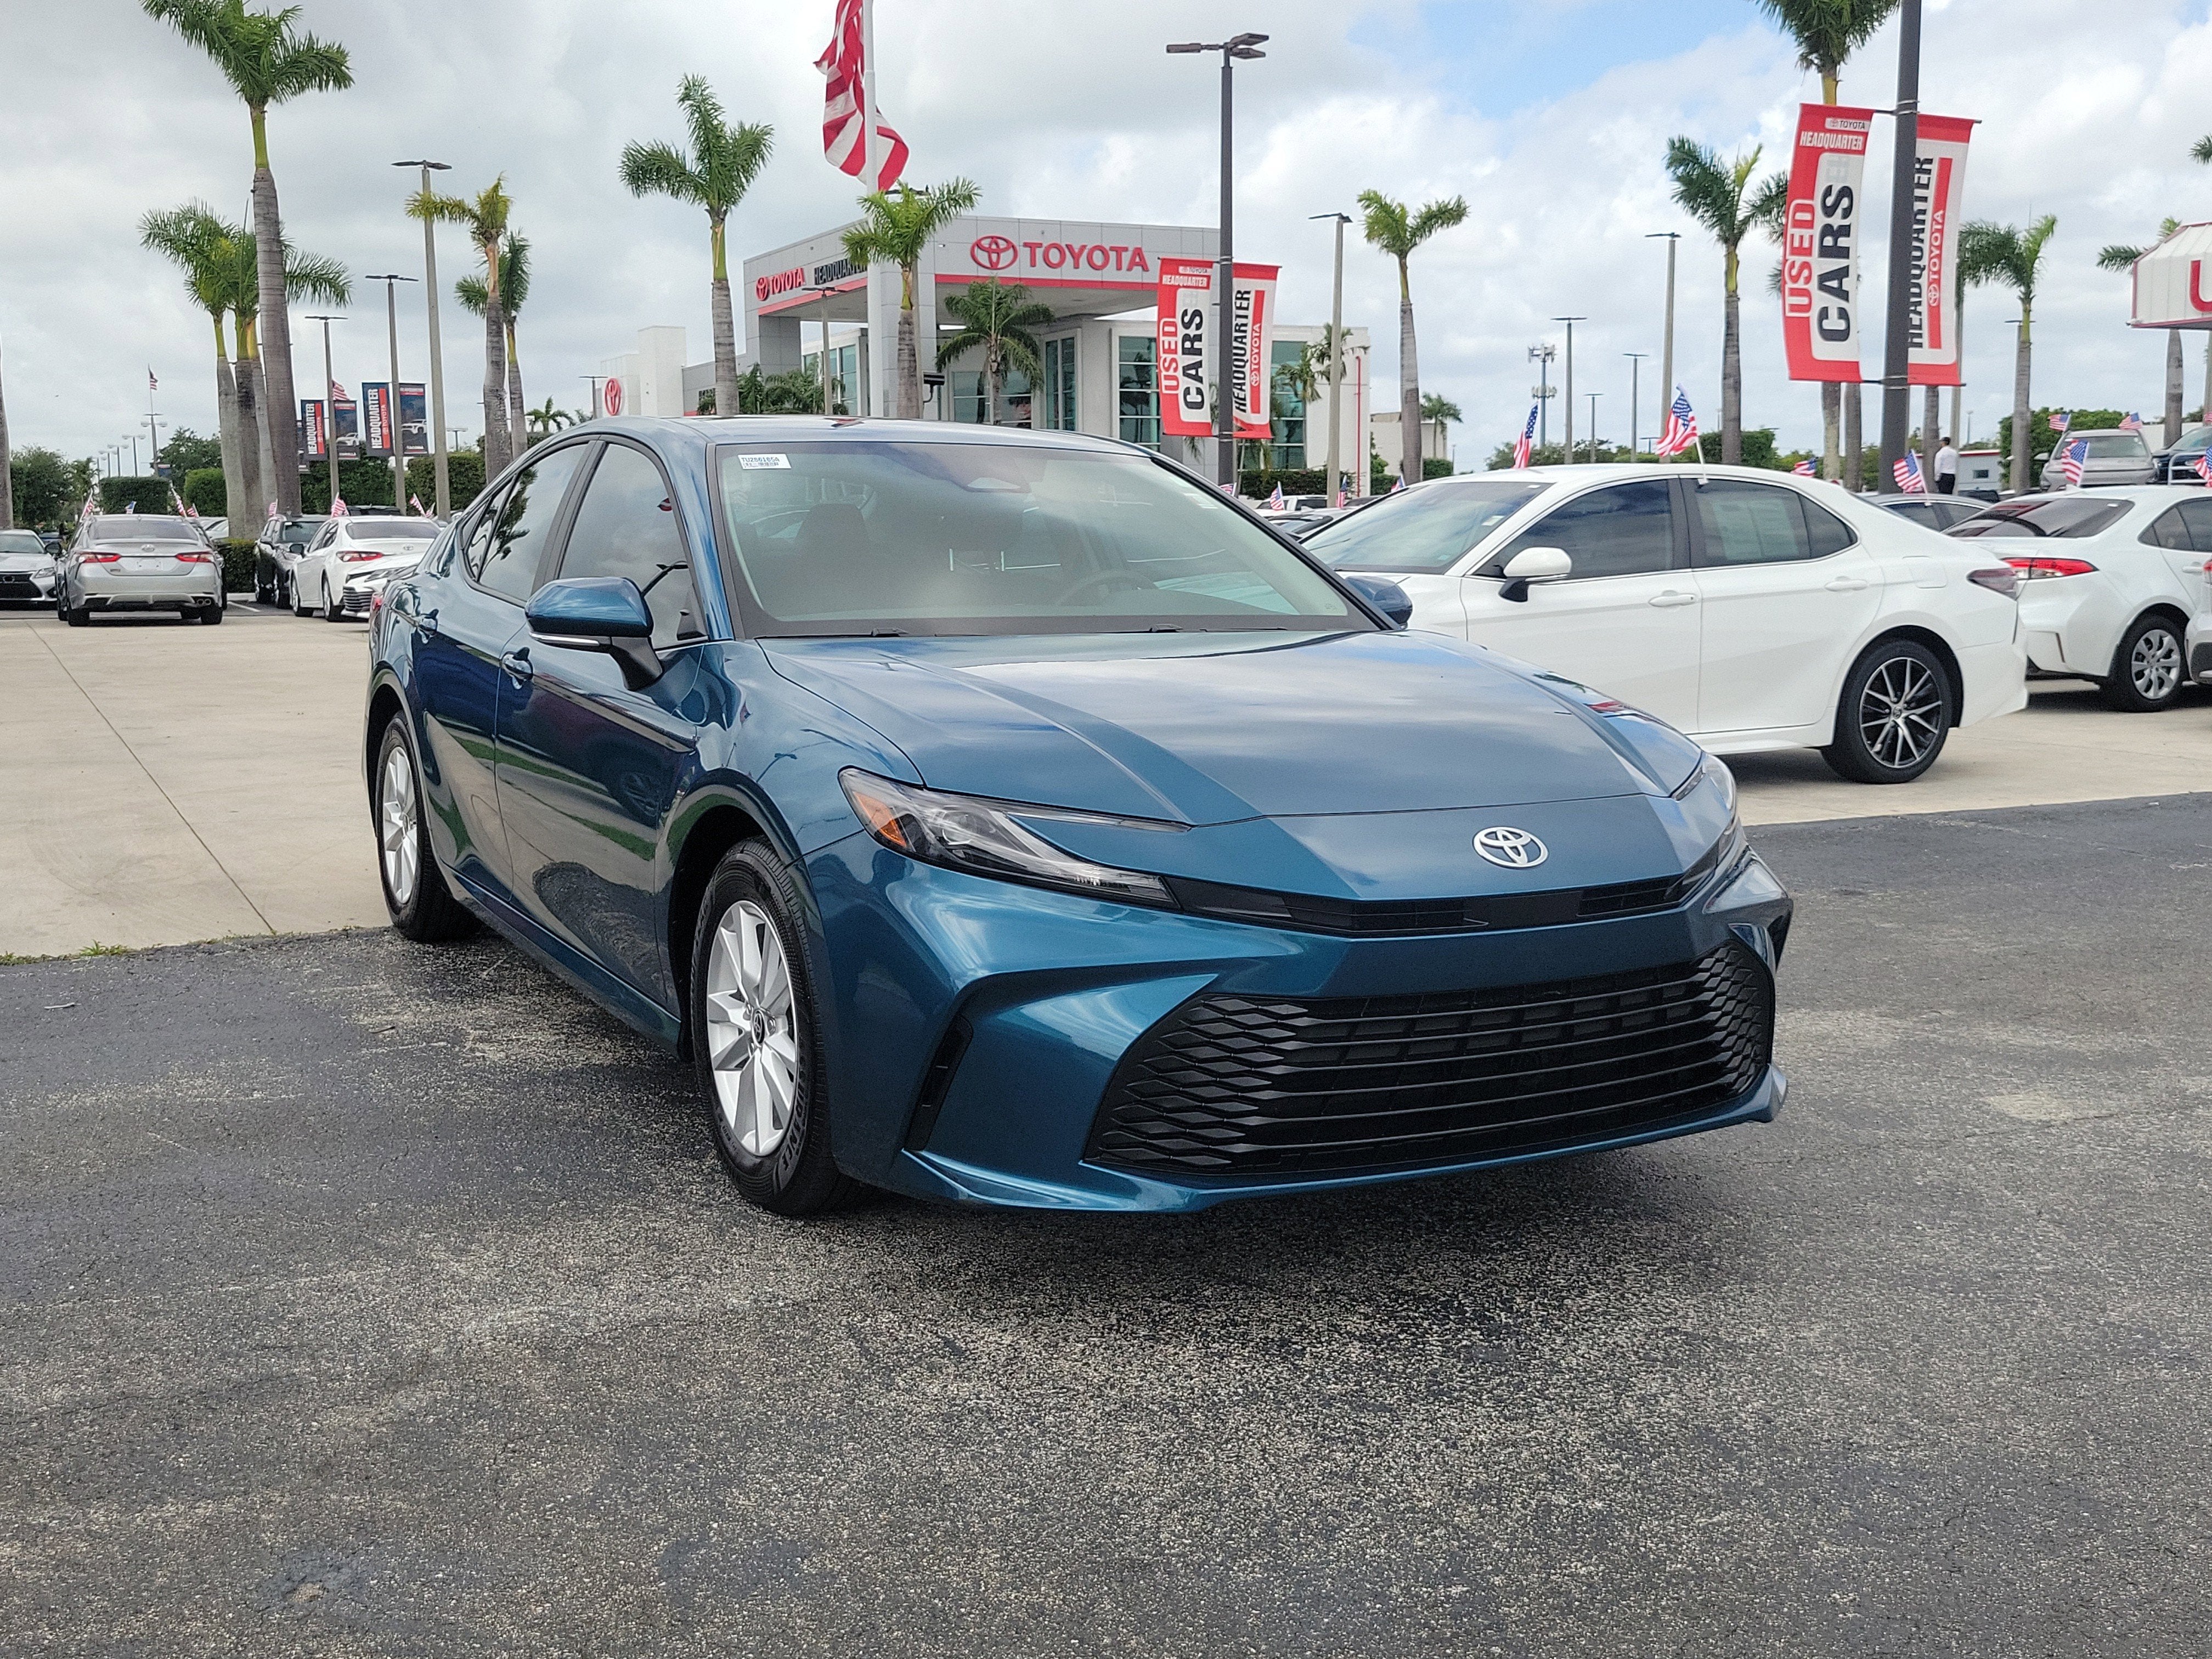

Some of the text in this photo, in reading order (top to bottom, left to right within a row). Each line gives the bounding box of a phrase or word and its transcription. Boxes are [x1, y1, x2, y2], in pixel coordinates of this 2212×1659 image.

[1800, 131, 1863, 151] HEADQUARTER
[1840, 120, 1865, 129] TOYOTA
[1023, 242, 1150, 272] TOYOTA
[1785, 199, 1815, 318] USED
[1816, 184, 1854, 342] CARS
[1929, 210, 1945, 281] TOYOTA
[769, 267, 805, 295] TOYOTA
[1163, 275, 1207, 287] HEADQUARTER
[1160, 318, 1179, 394] USED
[1181, 308, 1205, 410] CARS
[1233, 290, 1251, 413] HEADQUARTER
[1251, 323, 1261, 370] TOYOTA
[306, 403, 318, 455] HEADQUARTER
[368, 388, 382, 449] HEADQUARTER
